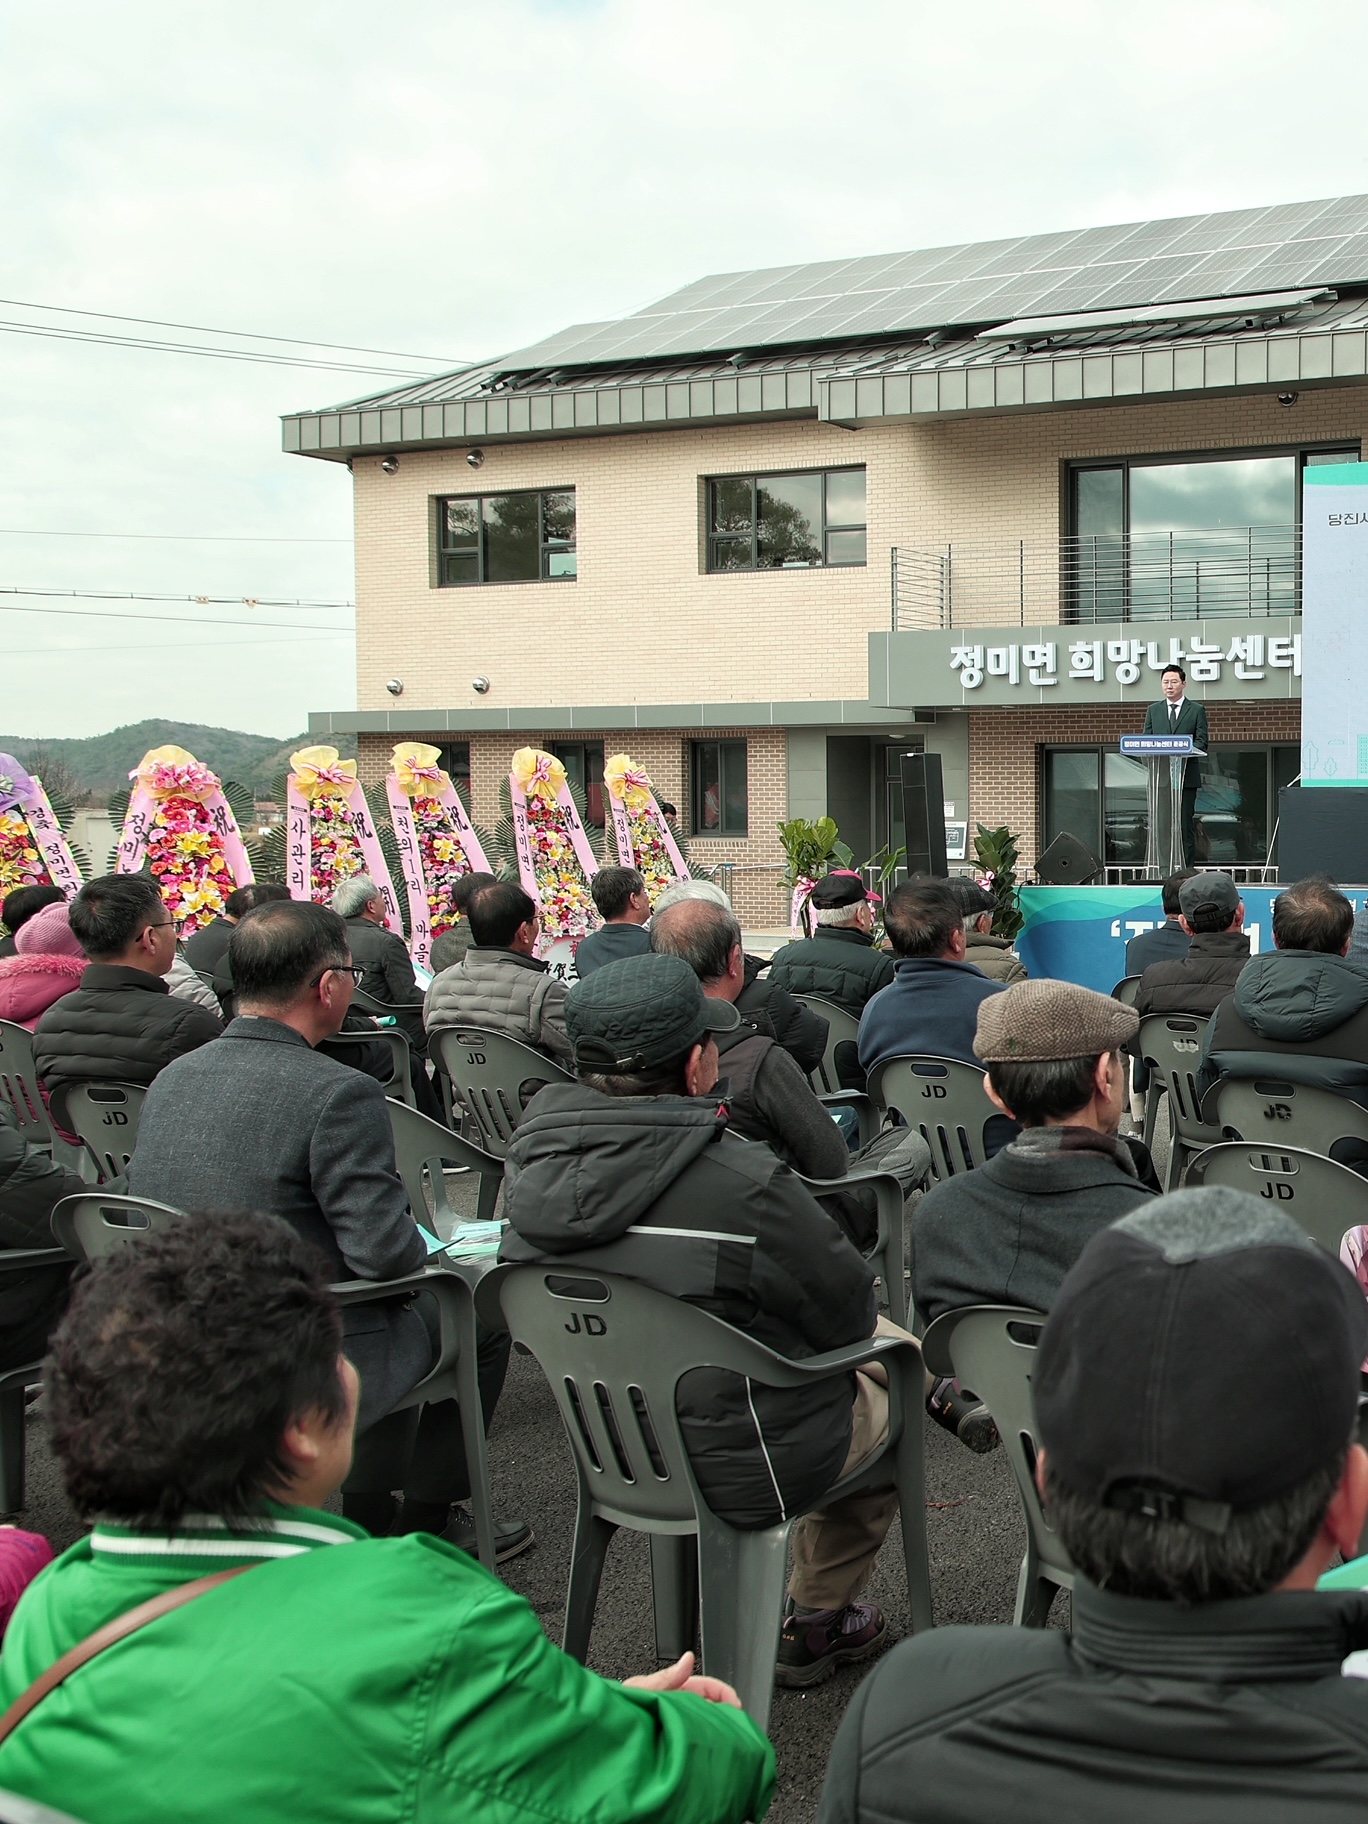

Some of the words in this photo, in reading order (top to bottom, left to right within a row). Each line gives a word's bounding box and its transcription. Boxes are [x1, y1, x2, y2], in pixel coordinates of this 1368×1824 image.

[950, 642, 1058, 689] 정미면
[1068, 634, 1302, 685] 희망나눔센터
[209, 806, 236, 837] 祝
[447, 805, 469, 832] 祝
[561, 805, 581, 831] 祝
[516, 814, 531, 872] 정미면
[616, 817, 631, 864] 정미면
[291, 817, 307, 892] 사관리
[466, 1051, 486, 1066] JD
[921, 1084, 947, 1099] JD
[102, 1111, 129, 1126] JD
[1263, 1103, 1292, 1121] JD
[1259, 1182, 1295, 1201] JD
[565, 1312, 608, 1337] JD
